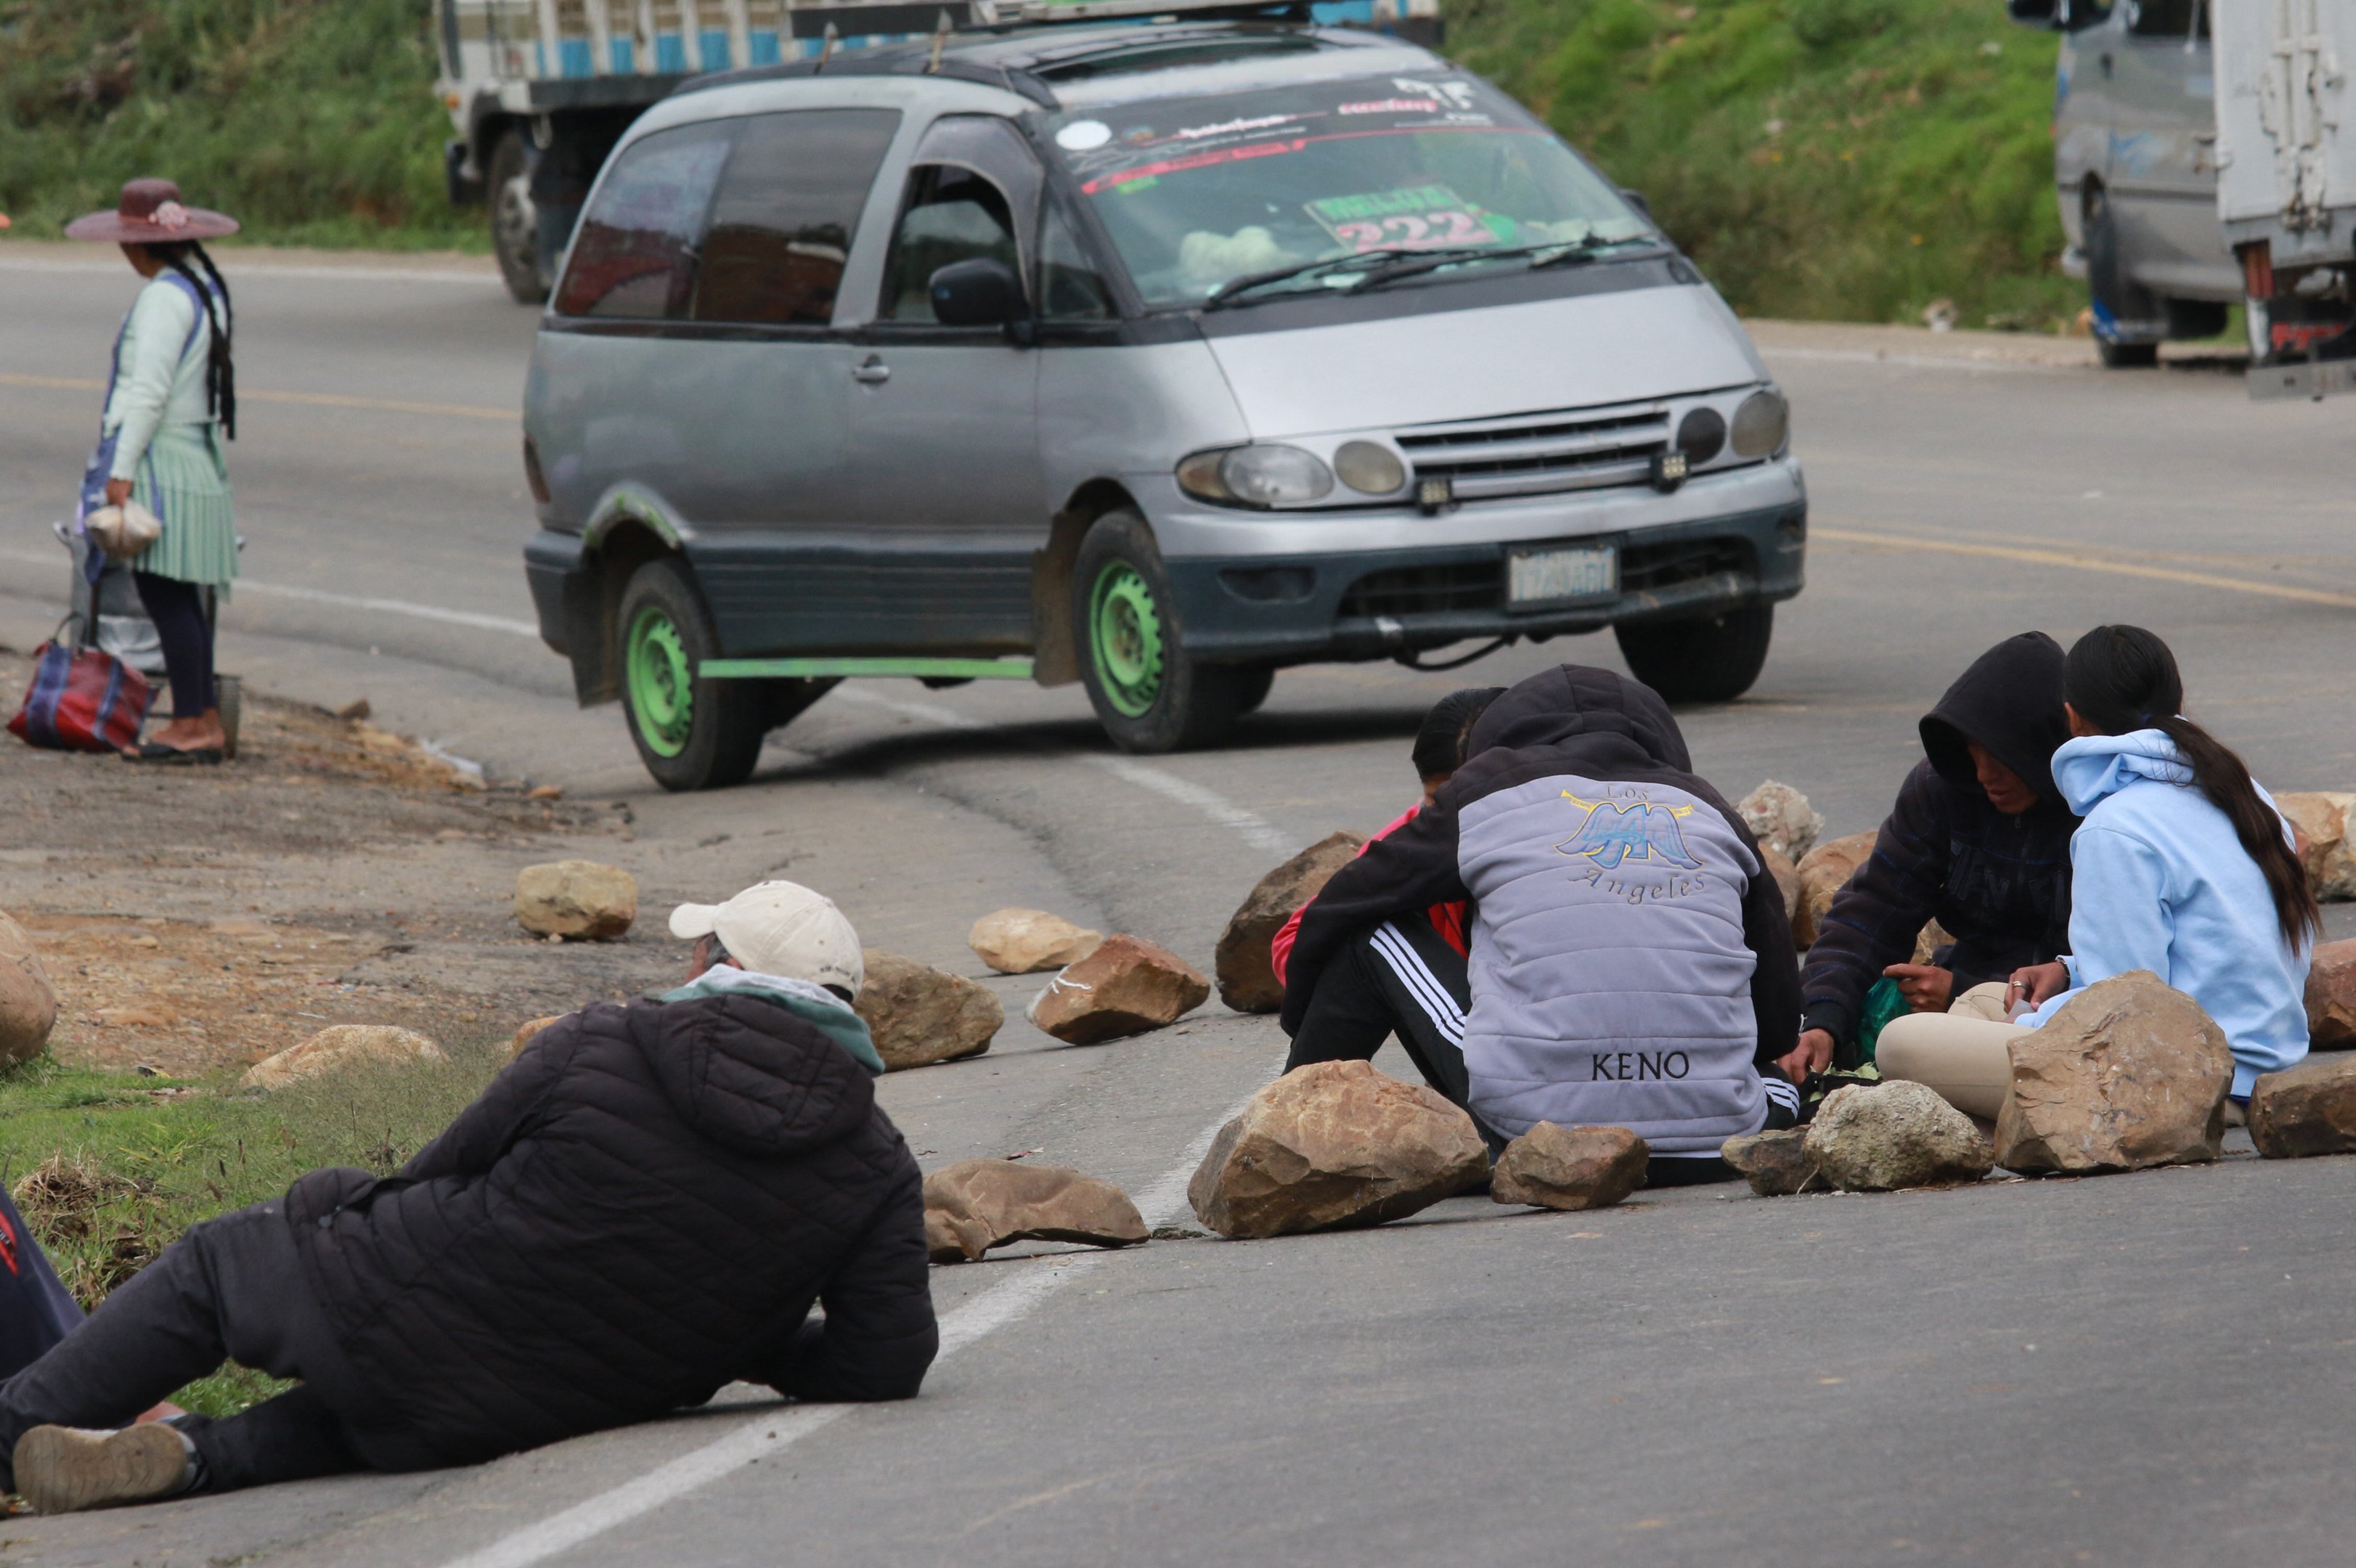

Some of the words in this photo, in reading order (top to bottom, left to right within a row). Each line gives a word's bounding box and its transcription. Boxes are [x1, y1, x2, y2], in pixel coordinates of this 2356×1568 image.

[1335, 211, 1493, 254] 222
[1607, 785, 1650, 802] Los
[1568, 869, 1705, 905] Angeles
[1591, 1050, 1689, 1081] KENO
